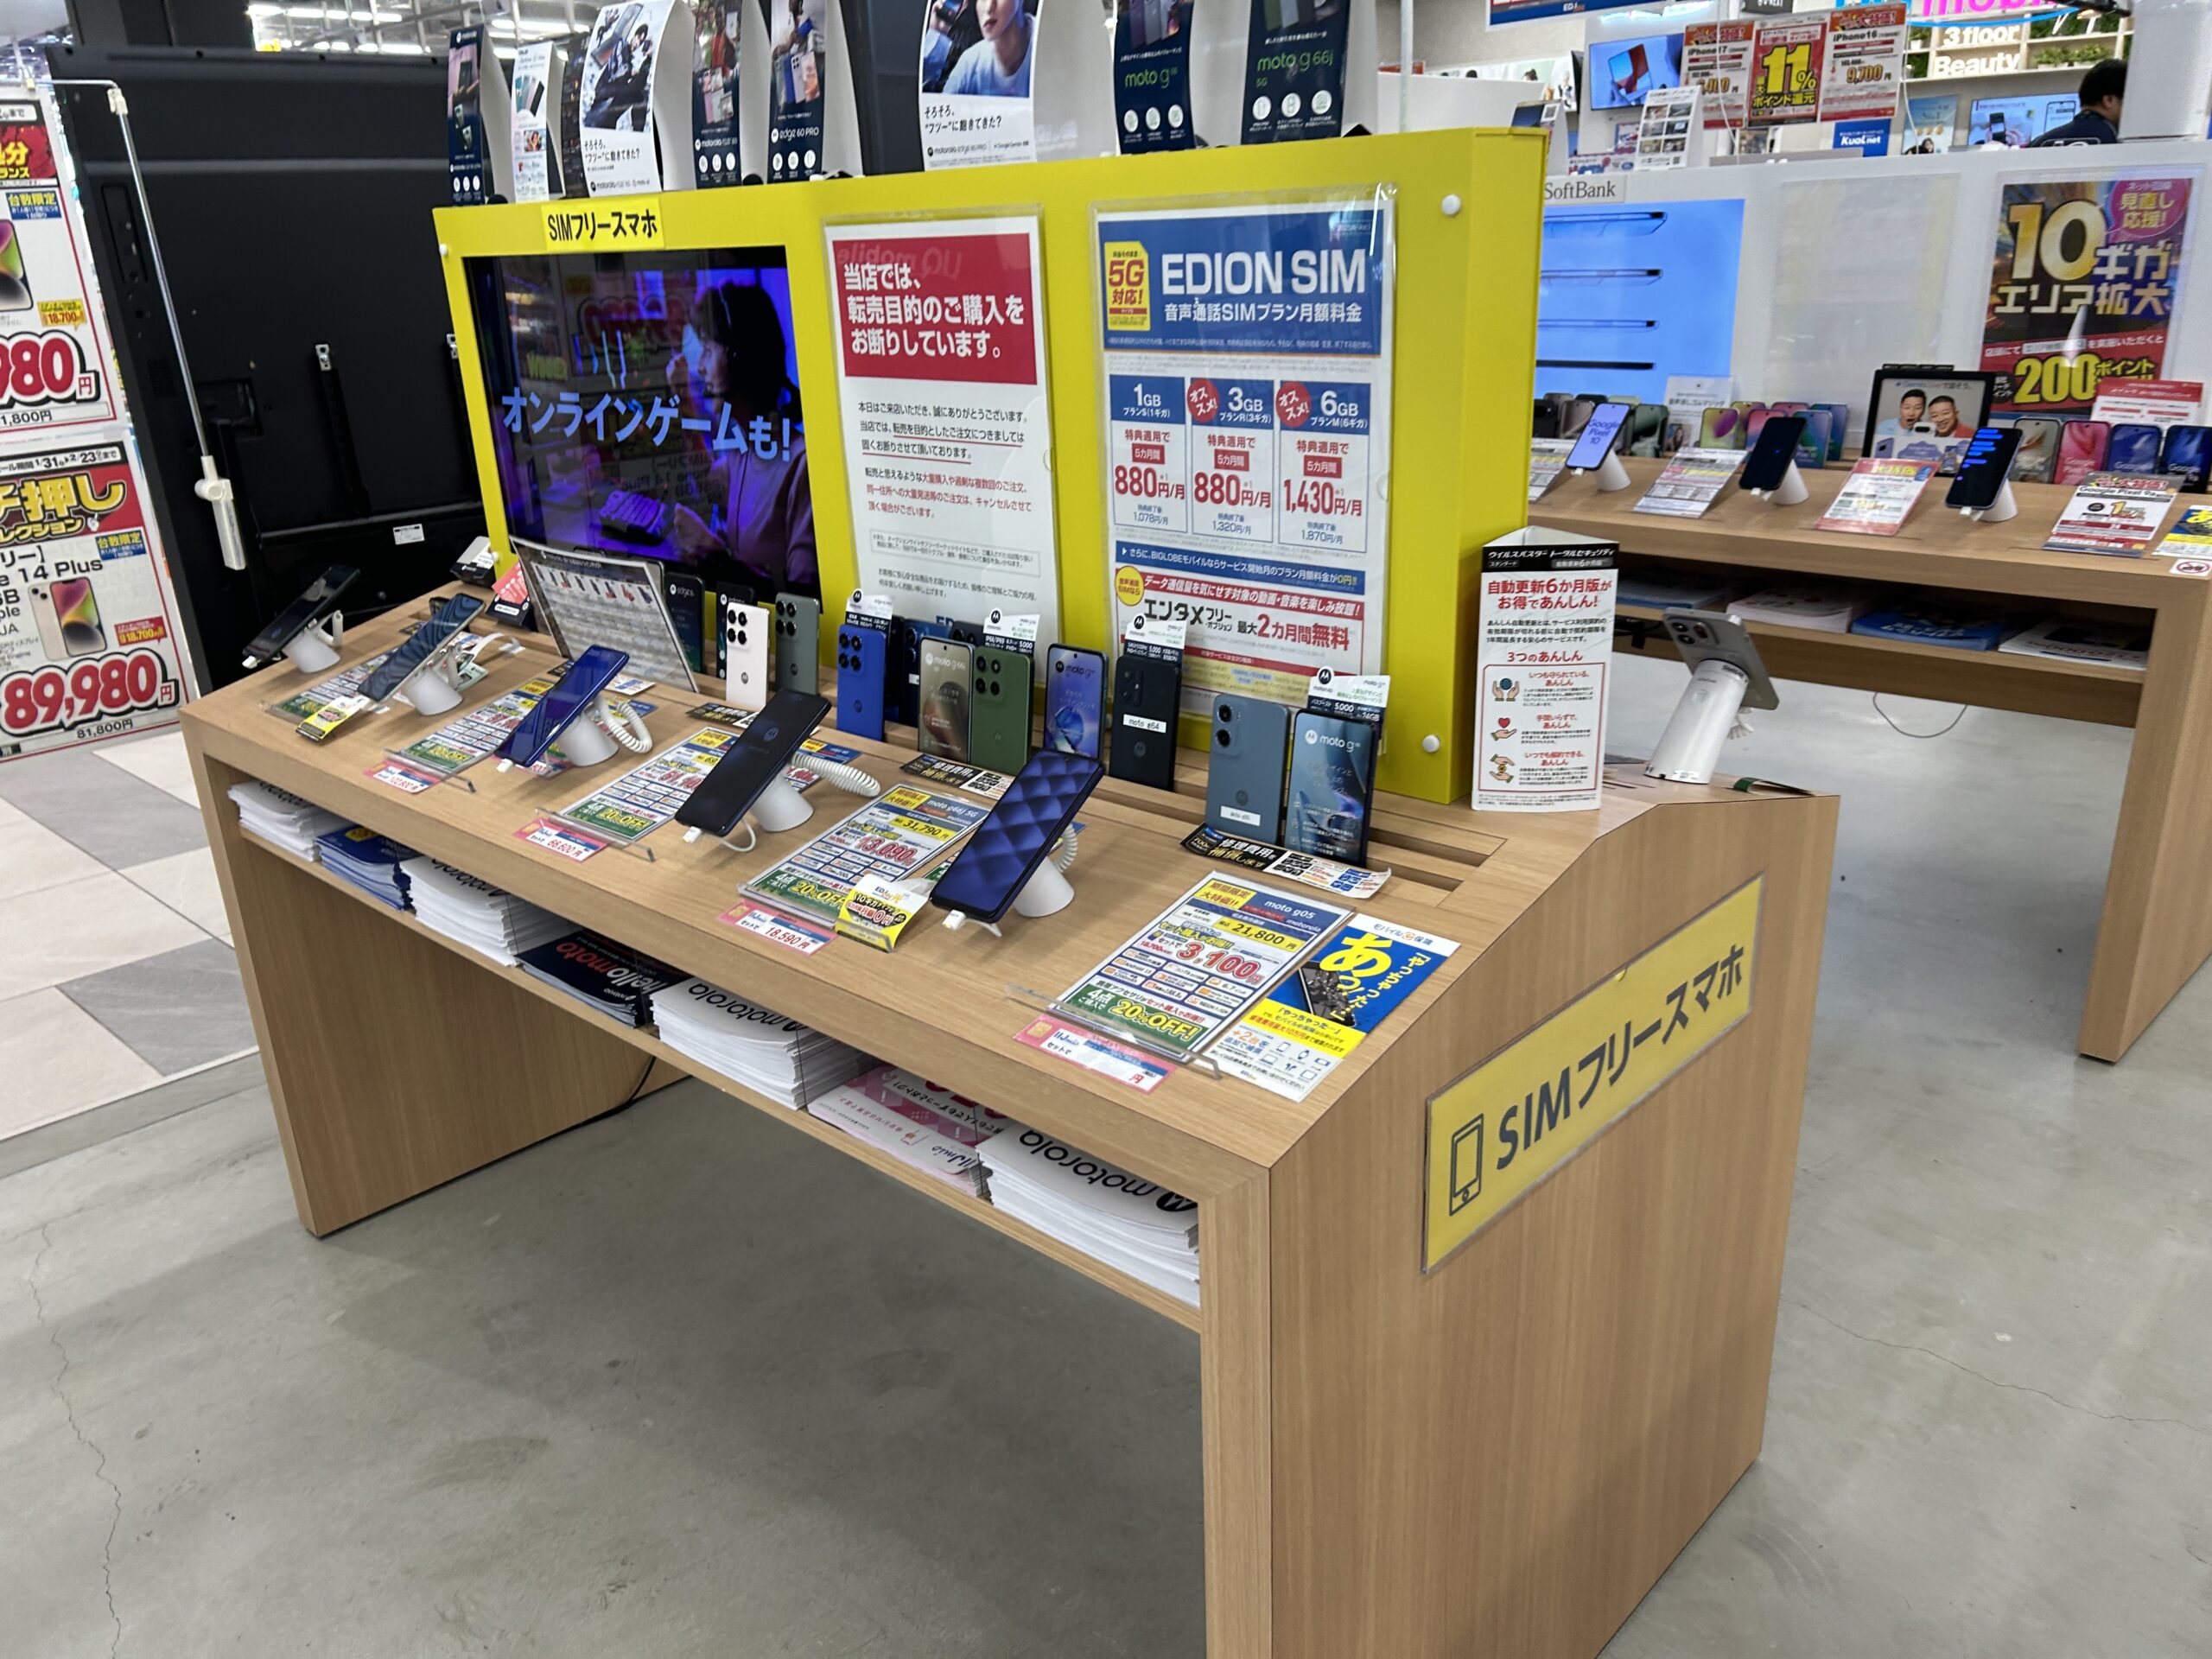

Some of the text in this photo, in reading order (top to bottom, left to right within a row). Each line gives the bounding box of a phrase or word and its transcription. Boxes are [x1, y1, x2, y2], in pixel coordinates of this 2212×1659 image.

[1944, 24, 2020, 45] 3 floor
[1257, 49, 1333, 72] moto g 66j
[1934, 52, 2020, 76] Beauty
[1125, 68, 1157, 87] moto
[805, 127, 819, 137] PRO
[1545, 180, 1616, 200] SoftBank
[547, 209, 658, 243] SIMフリースマホ
[2008, 199, 2108, 282] 10
[1161, 249, 1365, 296] EDION SIM
[2091, 240, 2175, 282] ギガ
[843, 262, 921, 291] 当店では、
[1109, 259, 1145, 287] 5G
[1112, 288, 1143, 304] 対応!
[1993, 282, 2170, 316] エリア拡大
[847, 295, 1025, 326] 転売目的のご購入を
[1164, 303, 1363, 324] 音声通話SIMプラン月額料金
[851, 328, 1001, 359] お断りしています。
[2012, 353, 2103, 405] 200
[1134, 384, 1162, 407] 1GB
[1228, 386, 1264, 412] 3GB
[1319, 390, 1359, 416] 6GB
[501, 386, 791, 462] オンラインゲームも!
[2079, 485, 2116, 495] Google
[19, 559, 104, 582] 14 Plus
[1487, 579, 1612, 595] 自動更新6か月版が
[1497, 595, 1599, 610] お得であんしん!
[933, 653, 951, 666] moto
[1507, 650, 1584, 663] 3つのあんしん
[1319, 734, 1345, 748] moto
[927, 798, 948, 810] moto
[903, 820, 943, 836] 31,790
[1264, 899, 1317, 920] moto g05
[1231, 922, 1286, 945] 21,800
[1087, 988, 1116, 1004] 4点
[1109, 999, 1202, 1043] 20%OFF!
[1496, 944, 1745, 1172] SIMフリースマホ
[1128, 1072, 1145, 1084] 円
[1019, 1126, 1158, 1200] motorola
